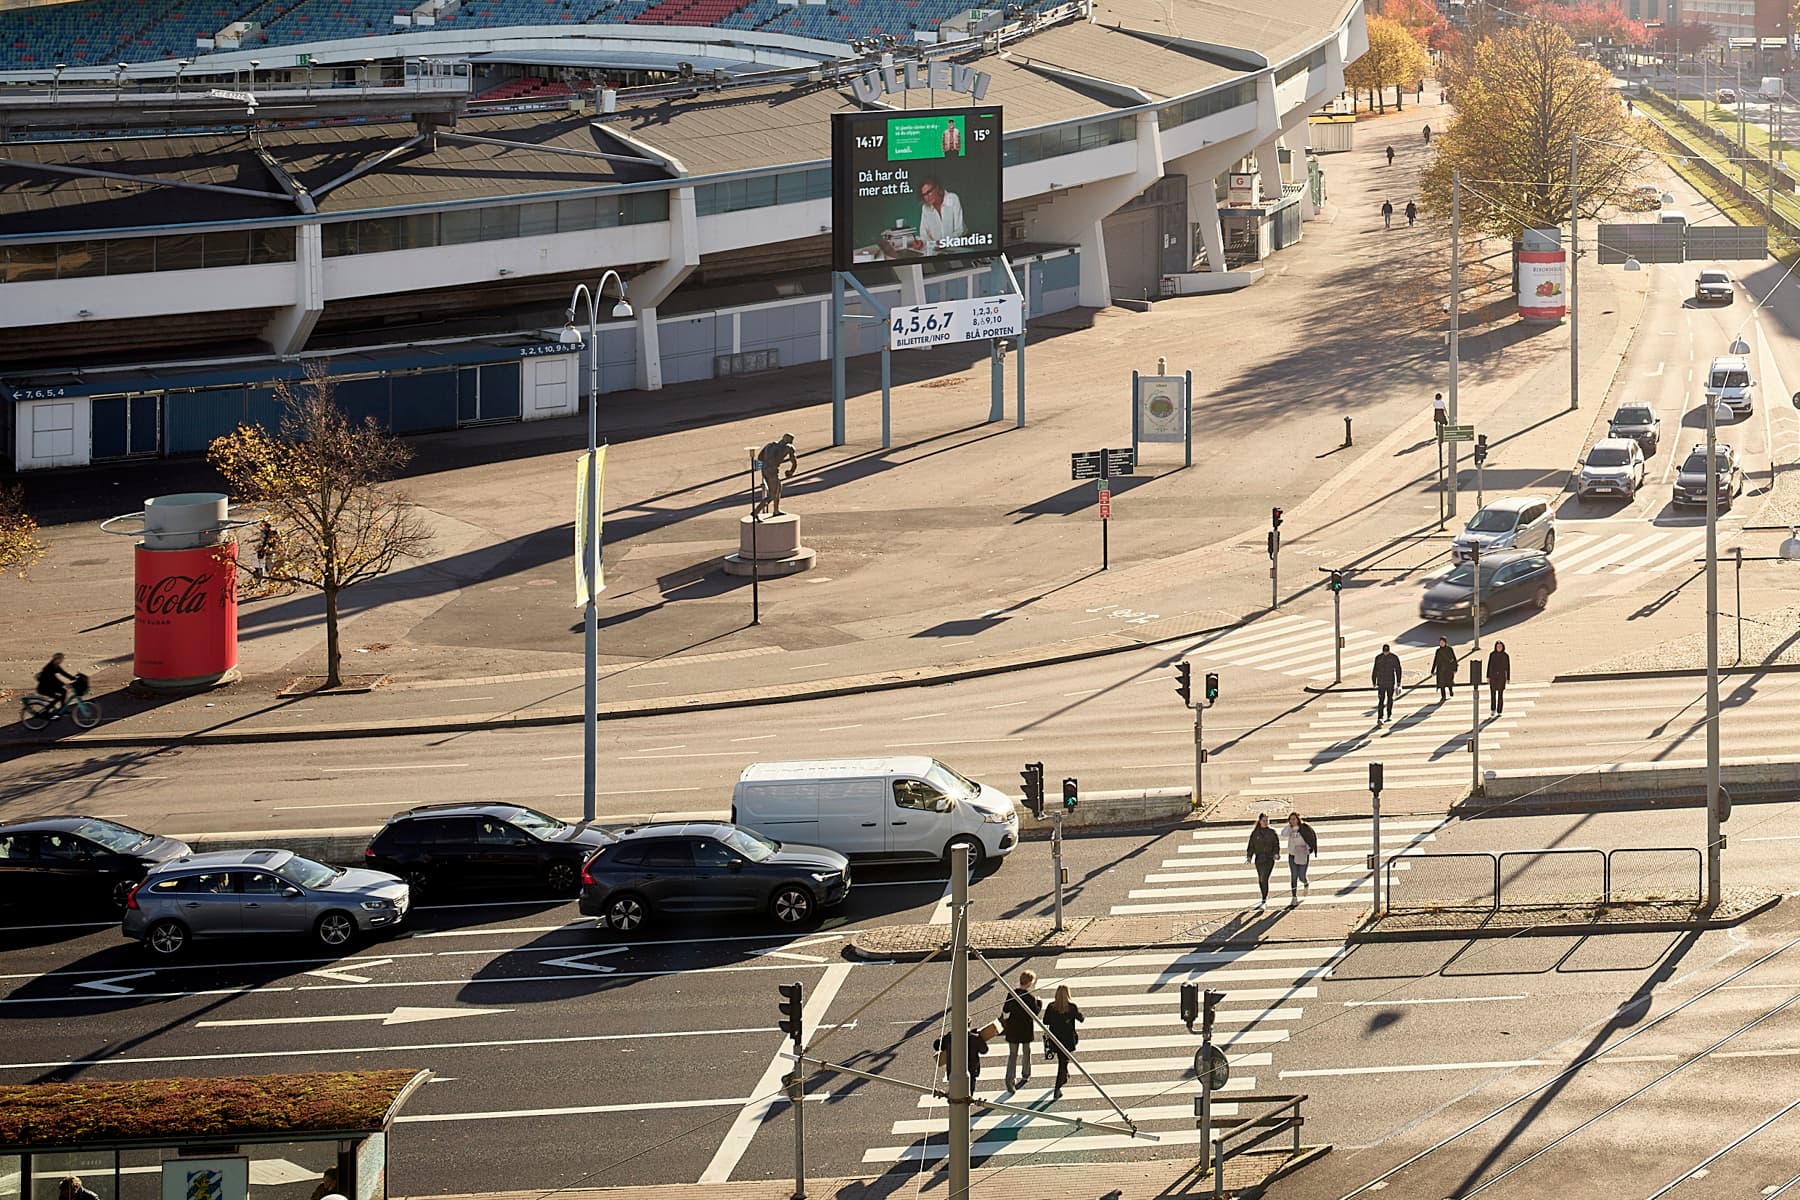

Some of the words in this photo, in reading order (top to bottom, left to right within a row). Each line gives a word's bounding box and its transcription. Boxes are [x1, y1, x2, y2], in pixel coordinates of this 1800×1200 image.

[851, 61, 991, 103] ULLEVI
[856, 136, 884, 148] 14:17
[859, 170, 873, 182] Då
[875, 169, 893, 181] har
[895, 168, 908, 180] du
[1236, 177, 1244, 186] G
[859, 187, 880, 197] mer
[882, 185, 898, 195] att
[900, 182, 913, 194] få.
[897, 333, 950, 347] BILJETTER/INFO
[966, 330, 981, 340] BLÅ
[983, 327, 1014, 337] PORTEN
